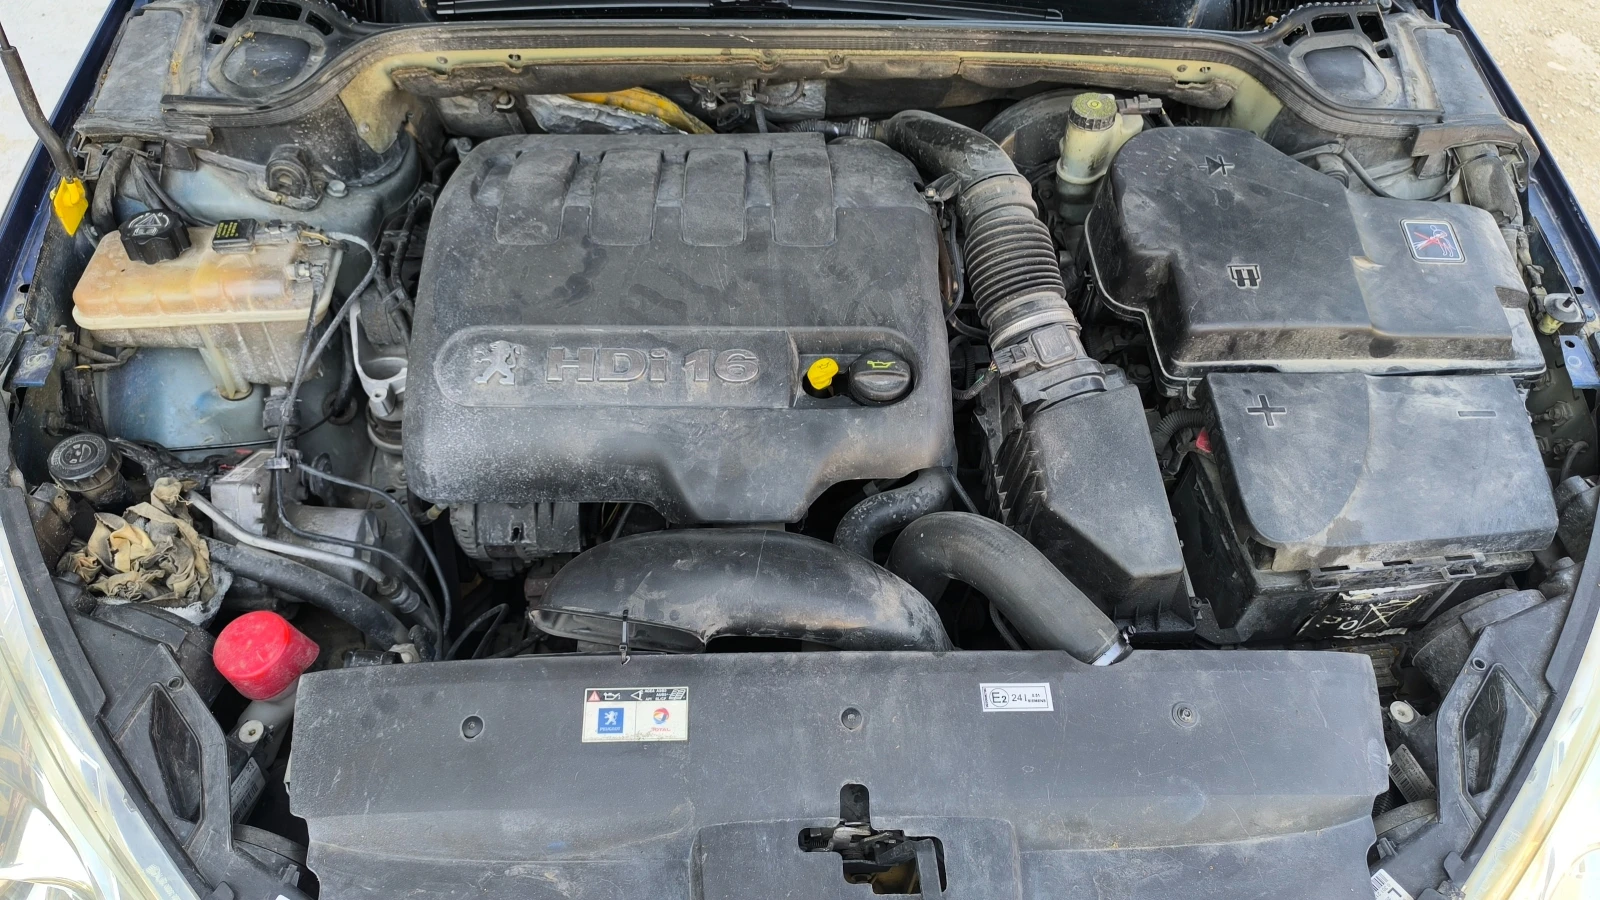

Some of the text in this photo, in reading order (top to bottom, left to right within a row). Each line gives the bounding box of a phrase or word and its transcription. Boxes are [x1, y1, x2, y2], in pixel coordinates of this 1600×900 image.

[546, 347, 759, 382] HDi 16
[1387, 887, 1402, 898] L
